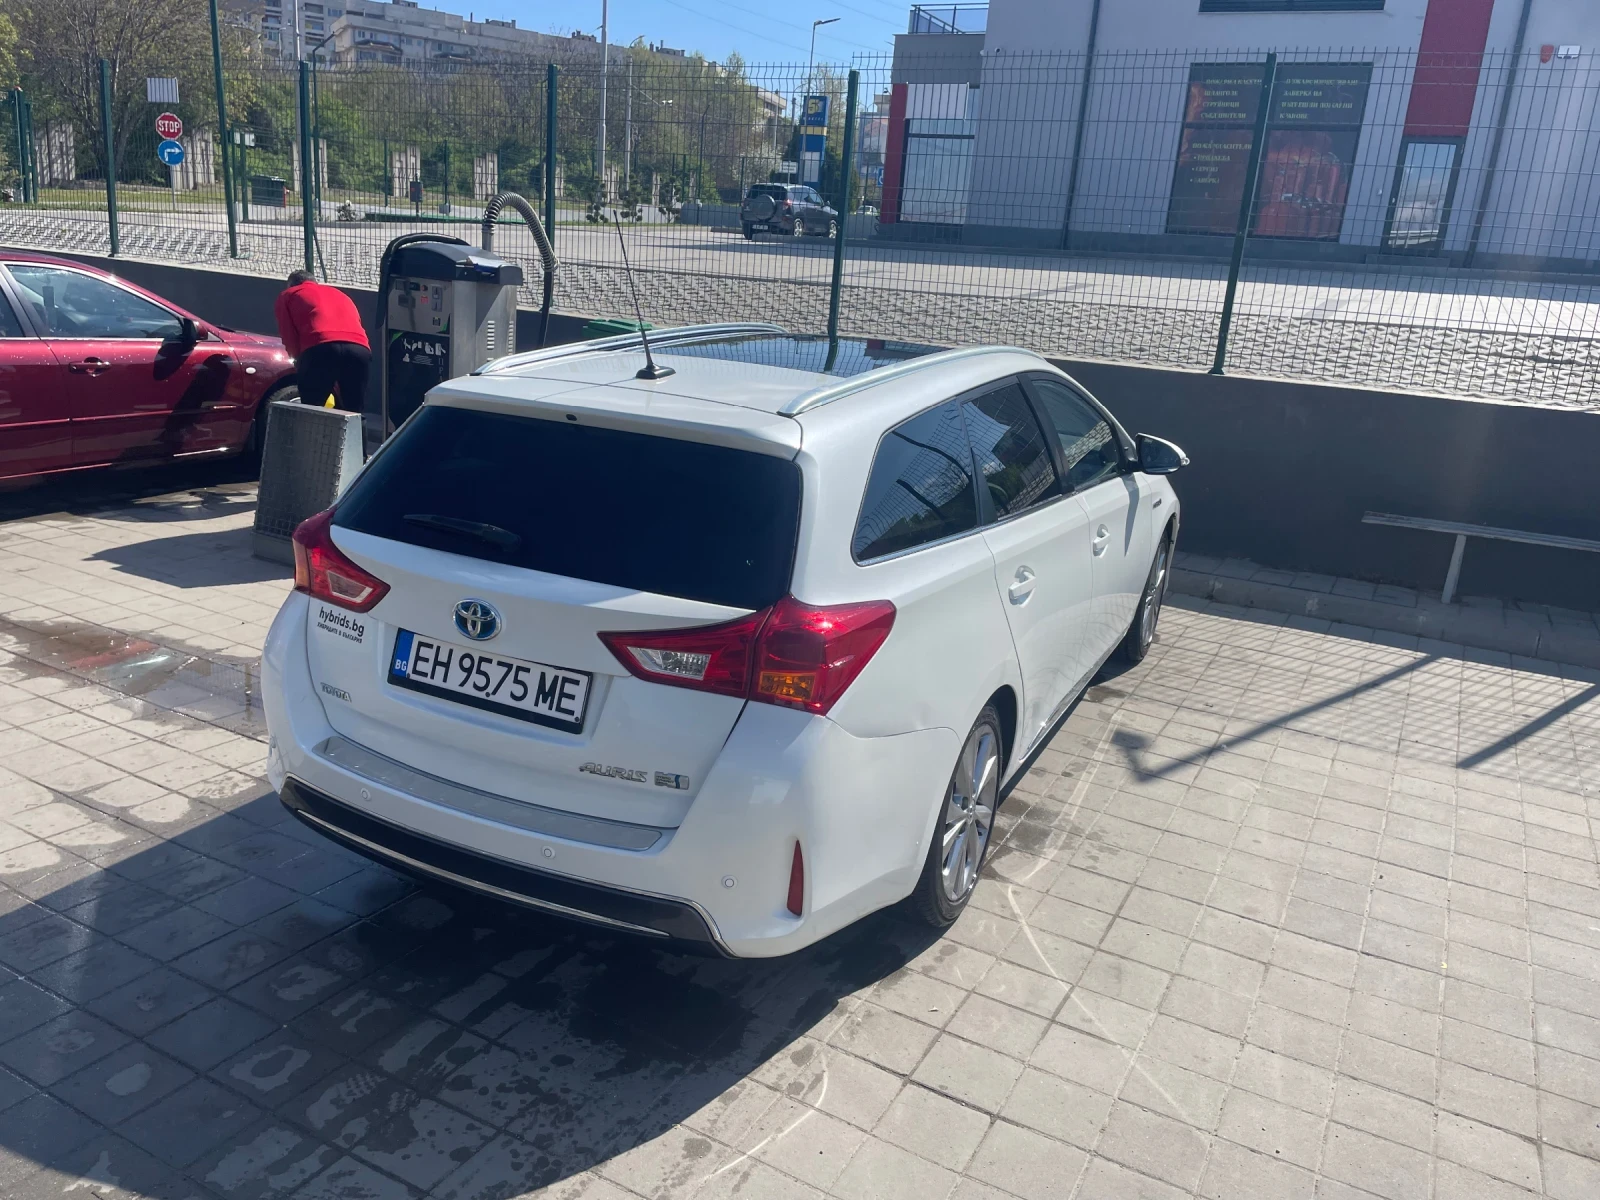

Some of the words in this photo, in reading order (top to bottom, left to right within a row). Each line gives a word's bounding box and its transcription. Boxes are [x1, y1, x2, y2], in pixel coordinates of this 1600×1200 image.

[158, 120, 180, 133] STOP
[319, 606, 365, 637] hybrids.bg
[394, 659, 408, 672] BG
[411, 641, 453, 683] EH
[458, 652, 531, 702] 9575
[533, 671, 581, 716] ME
[579, 762, 648, 783] AURIS
